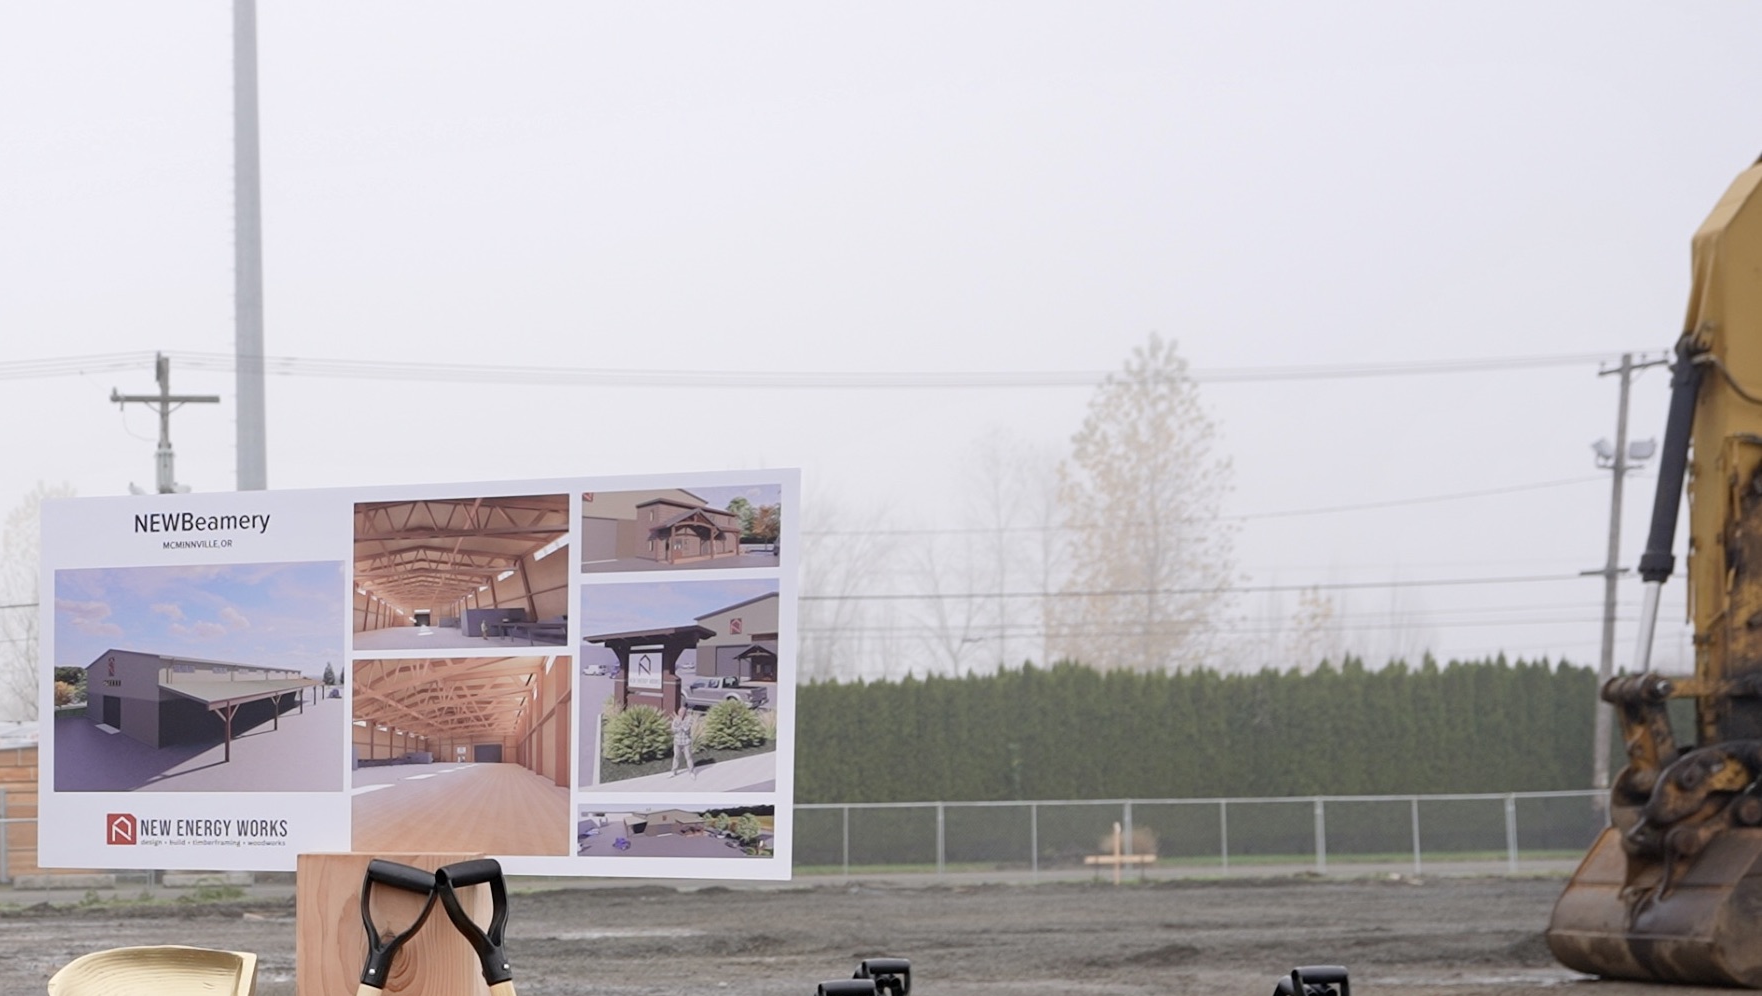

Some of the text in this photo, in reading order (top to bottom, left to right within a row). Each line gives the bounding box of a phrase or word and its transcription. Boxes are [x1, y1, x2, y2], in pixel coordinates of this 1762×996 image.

[134, 512, 271, 534] NEWBeamery
[140, 819, 288, 837] NEW ENERGY WORKS
[140, 839, 163, 847] design
